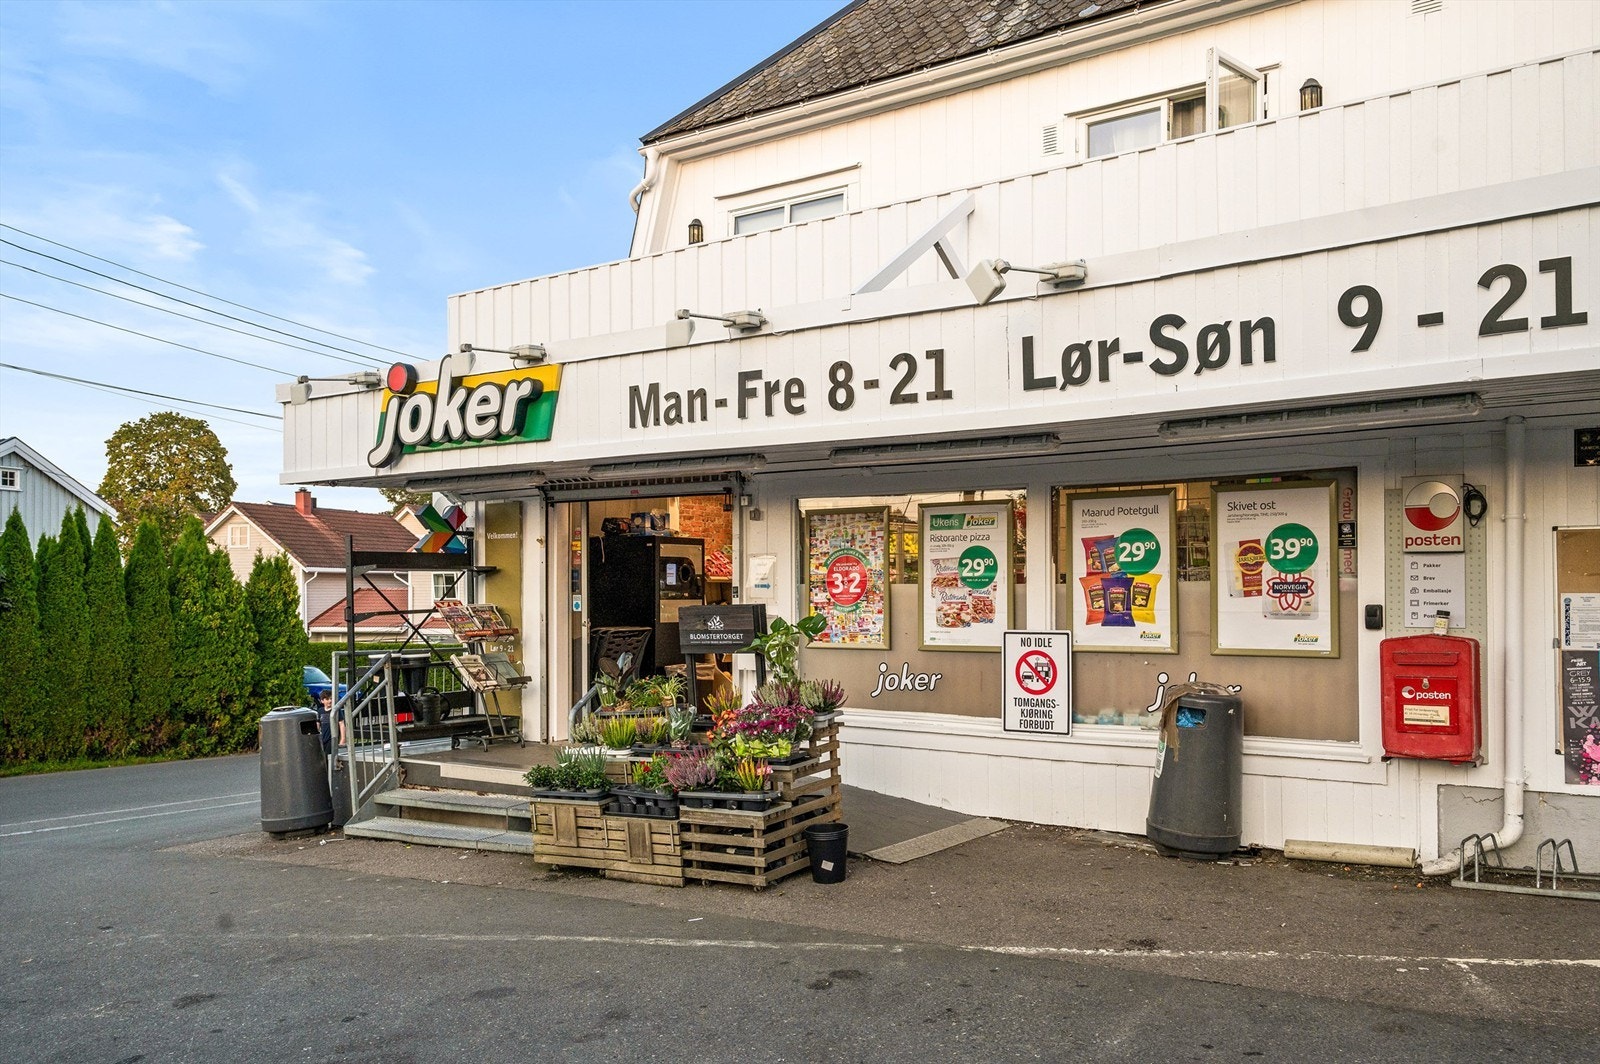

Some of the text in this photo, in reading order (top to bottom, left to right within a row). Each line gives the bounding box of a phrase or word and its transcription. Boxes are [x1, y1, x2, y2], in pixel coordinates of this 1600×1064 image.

[1022, 313, 1276, 391] Lør-Søn
[1337, 284, 1384, 353] 9
[1477, 256, 1588, 337] 21
[367, 353, 540, 468] joker
[1227, 500, 1276, 511] Skivet ost
[1342, 487, 1354, 520] Gratu
[1081, 504, 1159, 517] Maarud Potetgull
[932, 518, 959, 527] Ukens
[967, 515, 994, 528] joker
[487, 531, 518, 540] Velkommen!
[930, 533, 991, 543] Ristorante pizza
[1405, 534, 1461, 549] posten
[1118, 542, 1145, 562] 29
[1270, 538, 1300, 560] 39
[962, 558, 985, 577] 29
[832, 573, 844, 594] 3
[849, 572, 861, 593] 2
[1020, 637, 1053, 648] NO IDLE
[870, 662, 942, 698] joker
[1416, 691, 1452, 700] posten
[1013, 697, 1060, 709] TOMGANGS-
[1020, 709, 1053, 719] KJØRING
[1019, 719, 1055, 731] FORBUDT
